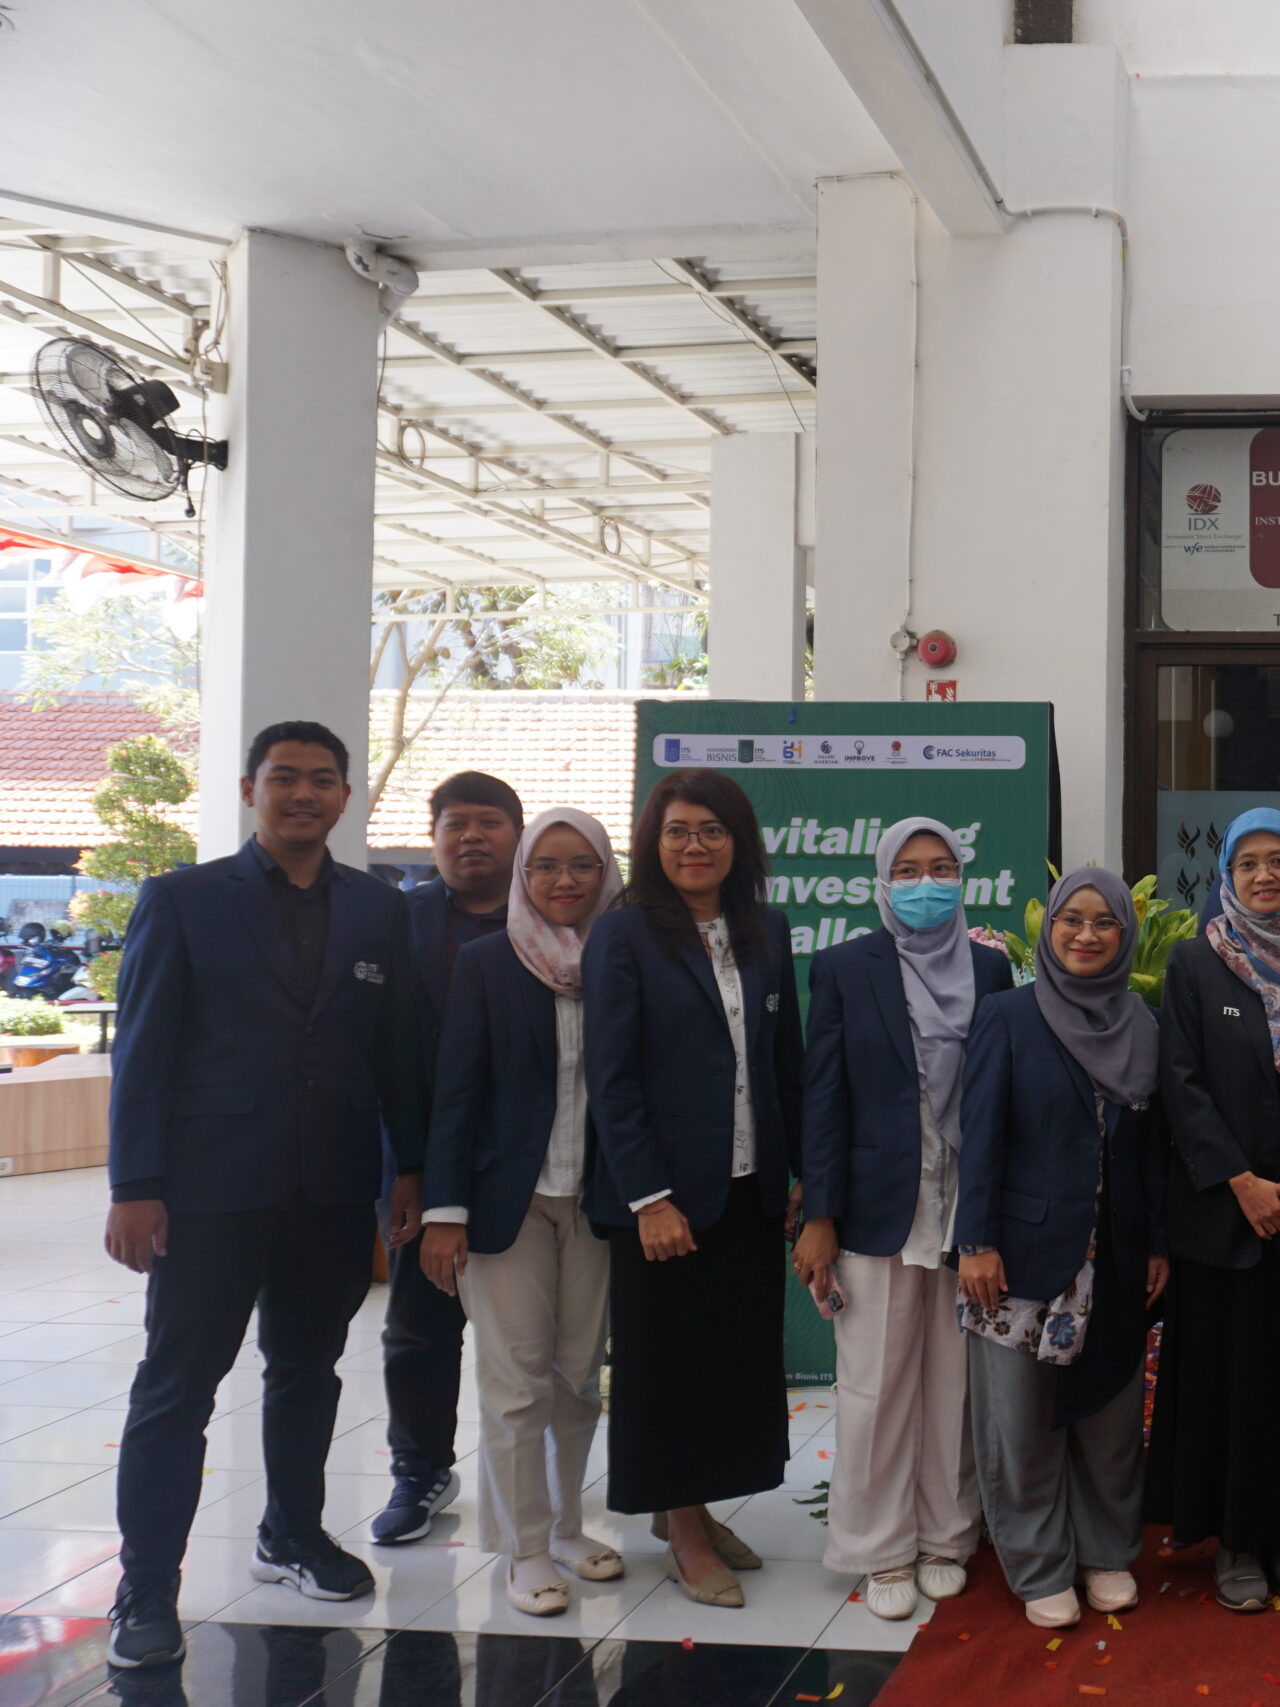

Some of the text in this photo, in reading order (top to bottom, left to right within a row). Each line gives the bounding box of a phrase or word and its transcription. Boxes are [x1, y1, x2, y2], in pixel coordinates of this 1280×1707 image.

[1187, 517, 1220, 531] IDX
[706, 752, 737, 762] BISNIS
[936, 748, 996, 758] FAC Sekuritas
[1223, 1006, 1240, 1017] ITS
